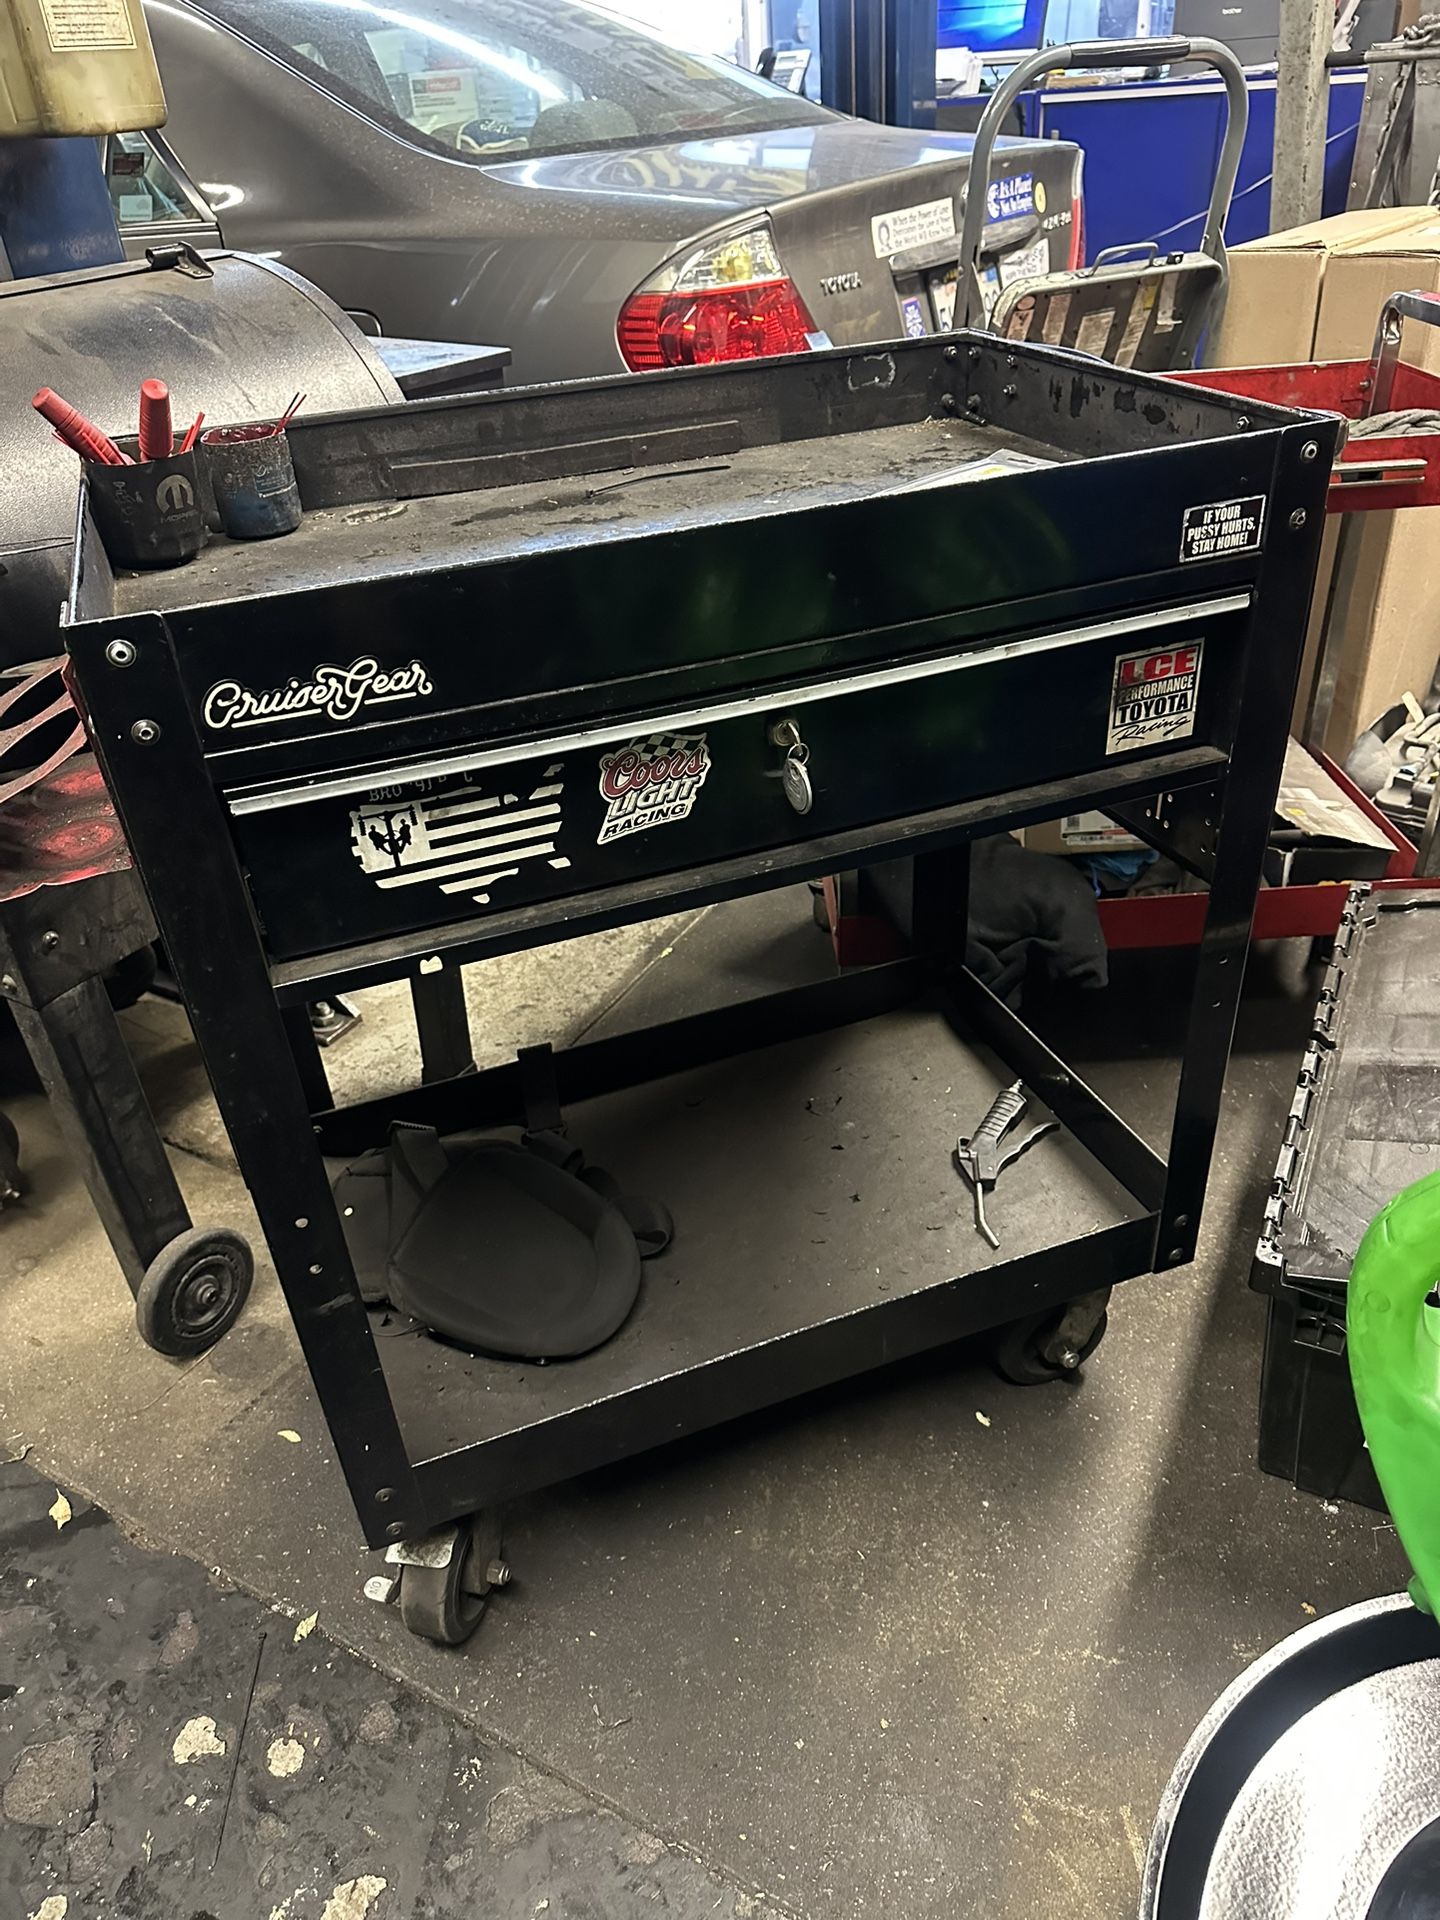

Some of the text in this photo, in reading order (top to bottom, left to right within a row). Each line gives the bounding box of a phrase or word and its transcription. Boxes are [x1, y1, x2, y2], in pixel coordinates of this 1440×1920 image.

[1187, 517, 1256, 542] PUSSY HURTS,
[1203, 505, 1241, 524] IF YOUR
[1191, 531, 1249, 555] STAY HOME!
[1121, 646, 1199, 687] LCE
[1118, 692, 1190, 724] TOYOTA
[1111, 716, 1191, 746] Racing
[602, 746, 706, 798] Coors
[609, 776, 701, 822] LIGHT
[603, 803, 687, 838] RACING
